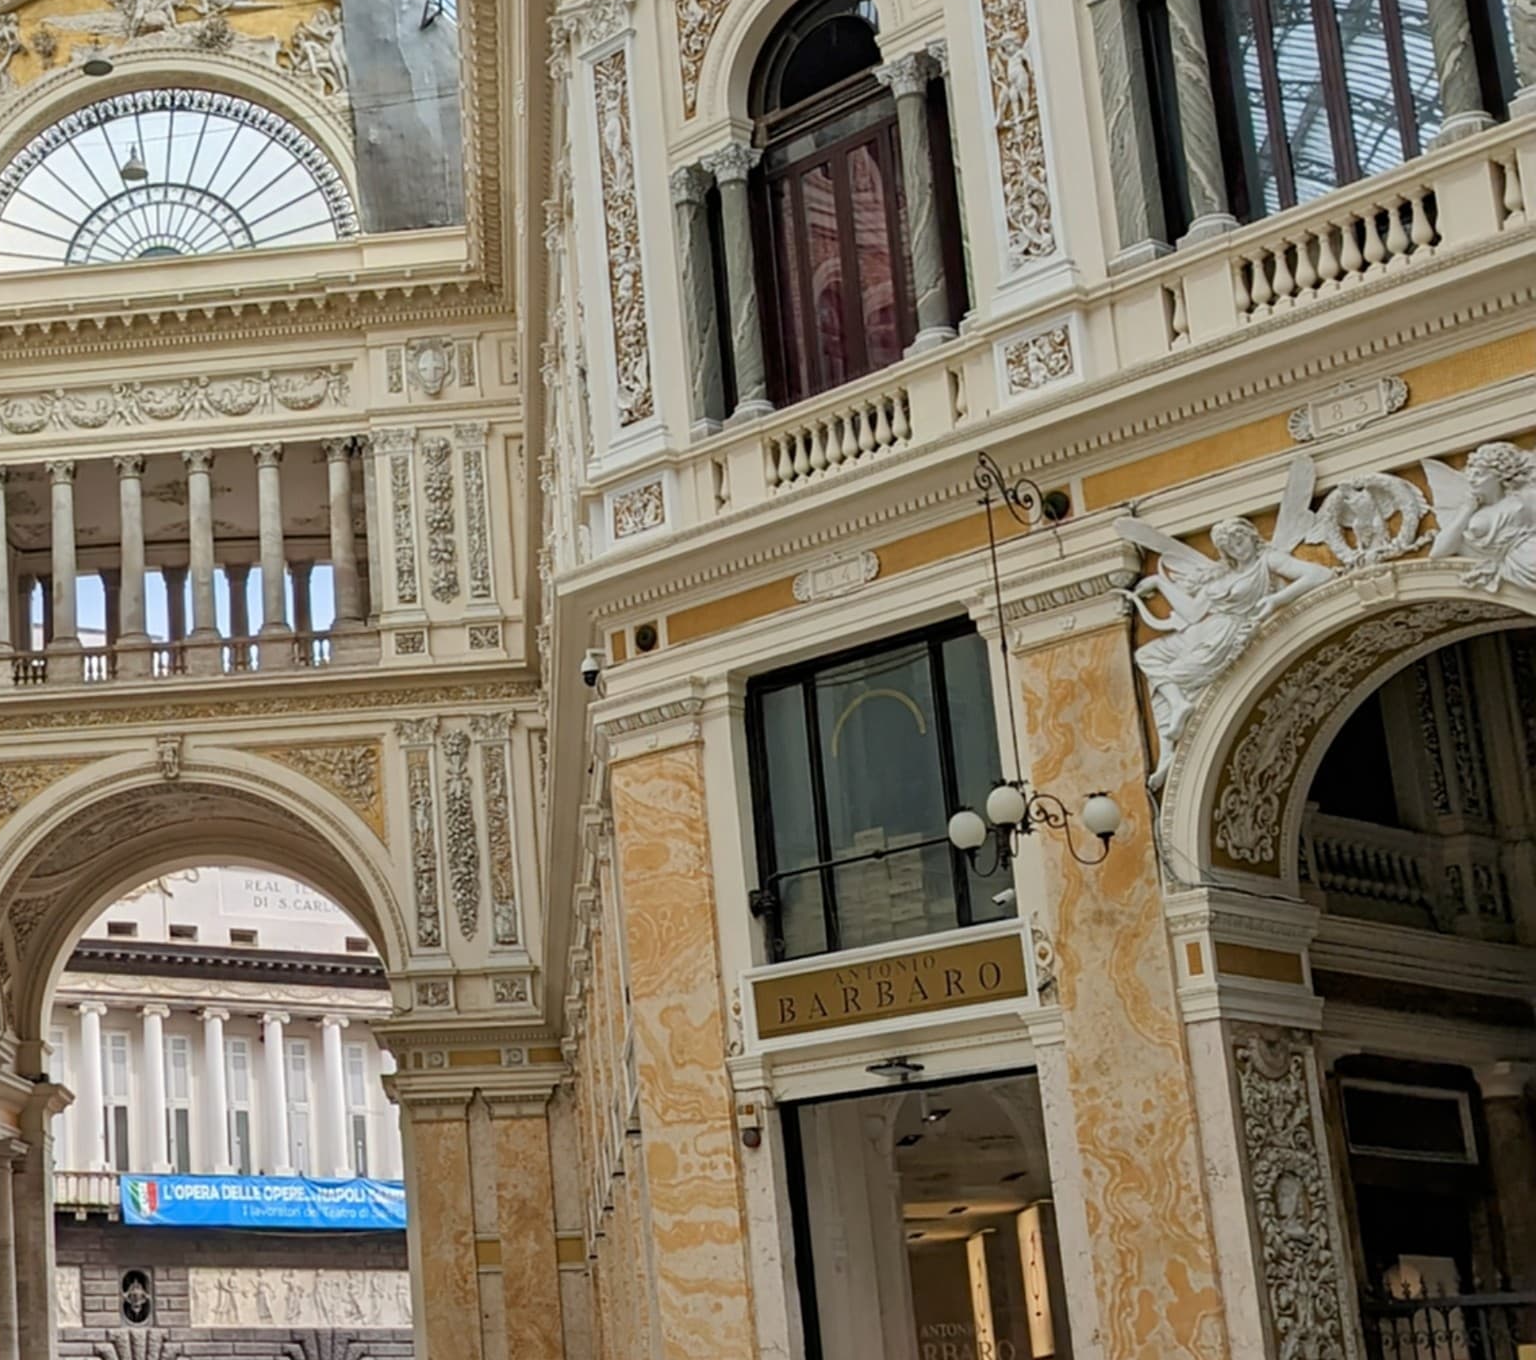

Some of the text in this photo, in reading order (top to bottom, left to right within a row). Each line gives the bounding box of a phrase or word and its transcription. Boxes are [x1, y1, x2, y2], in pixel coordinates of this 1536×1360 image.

[1331, 395, 1368, 420] 83
[244, 879, 281, 893] REAL
[253, 896, 268, 909] DI
[833, 954, 937, 986] ANTONIO
[778, 961, 1001, 1025] BARBARO
[164, 1183, 220, 1201] L'OPERA
[221, 1184, 262, 1201] DELLE
